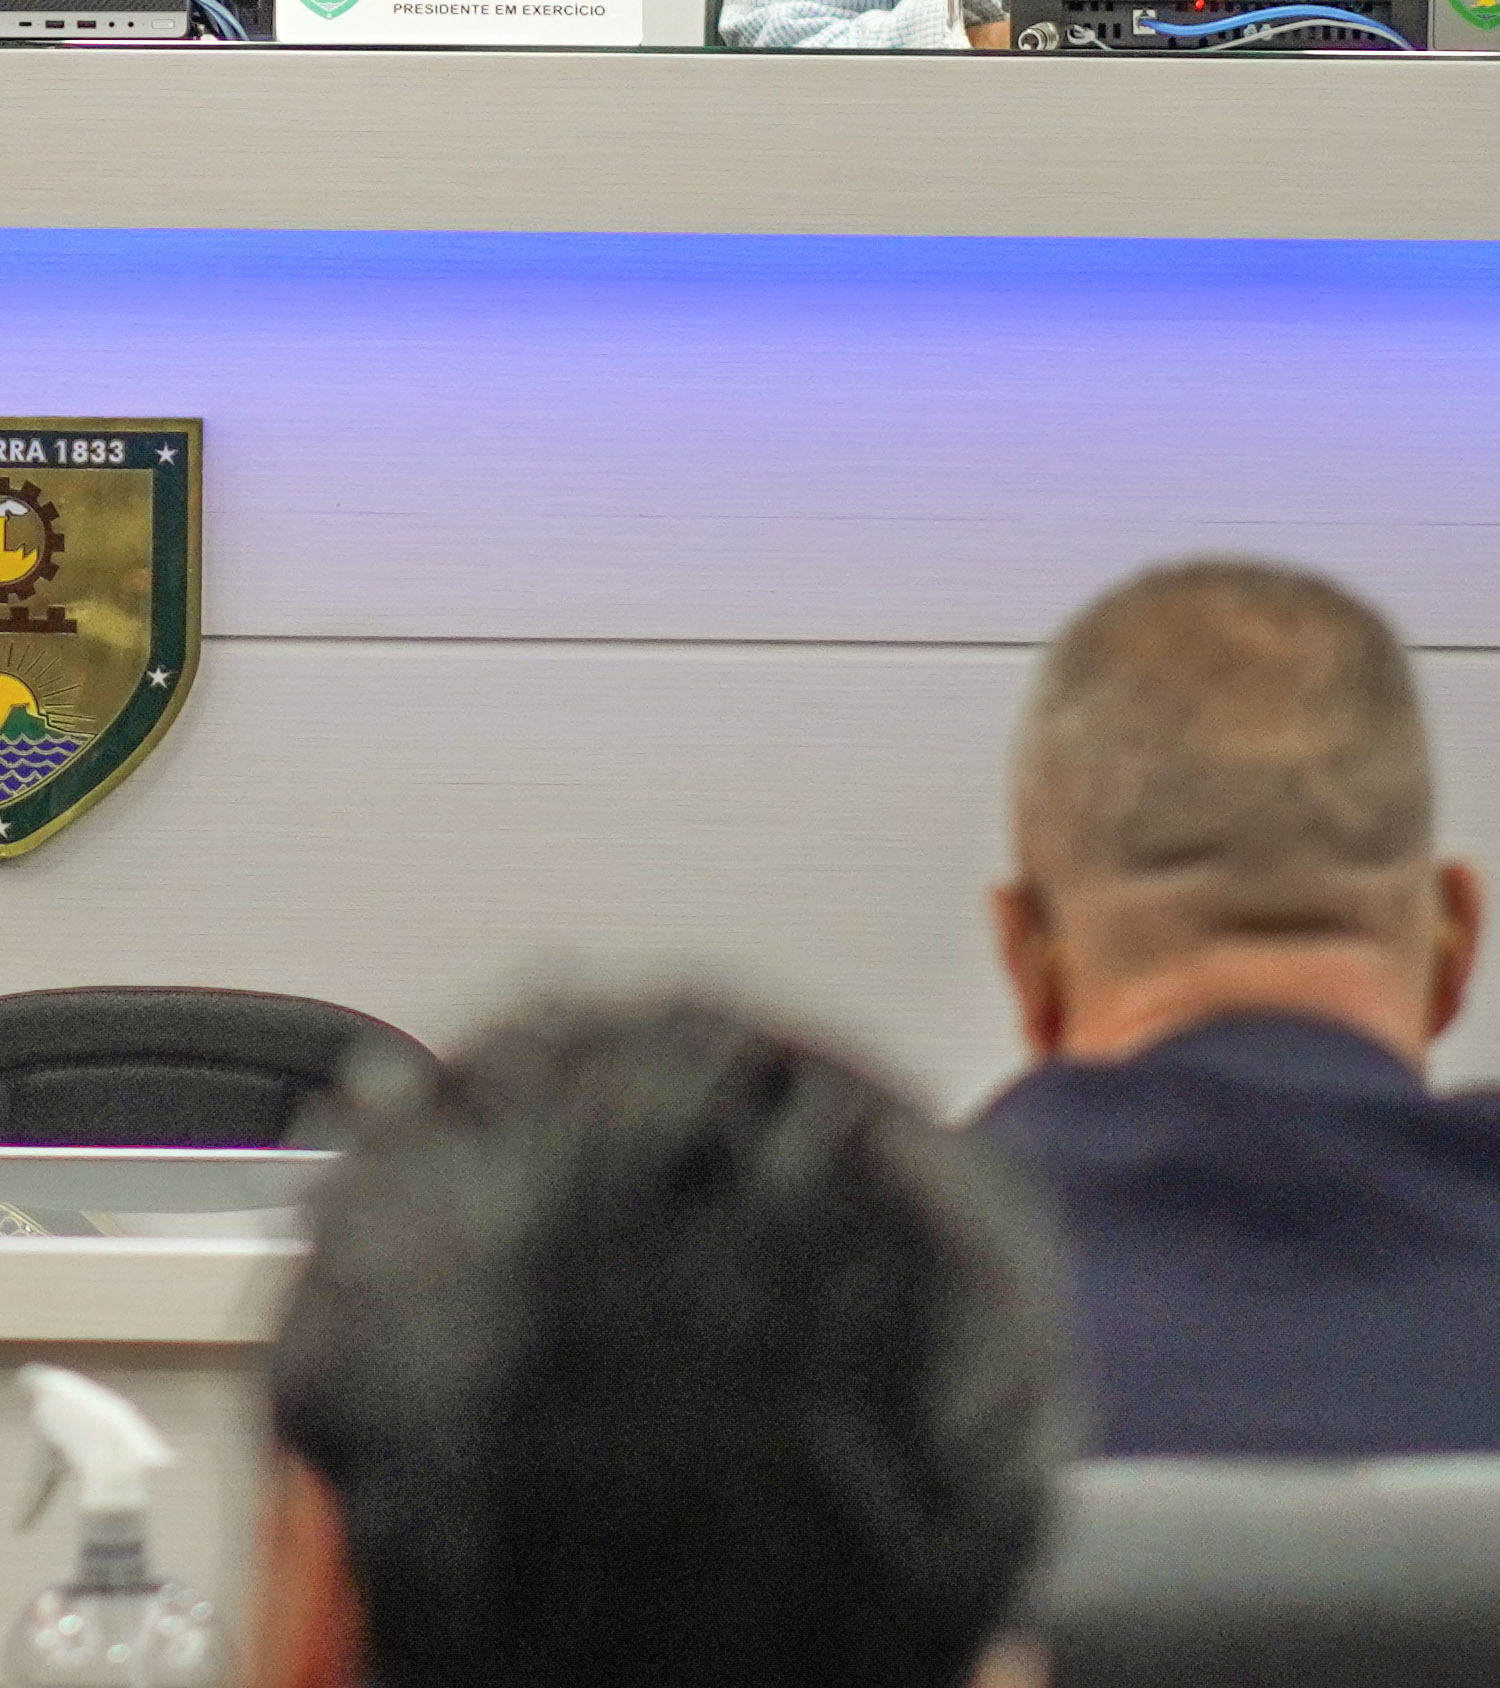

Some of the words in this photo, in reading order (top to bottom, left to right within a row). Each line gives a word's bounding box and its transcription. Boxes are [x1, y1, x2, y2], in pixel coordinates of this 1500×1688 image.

[393, 3, 490, 15] PRESIDENTE
[495, 4, 518, 15] EM
[522, 1, 606, 16] EXERCÍCIO
[55, 439, 126, 464] 1833
